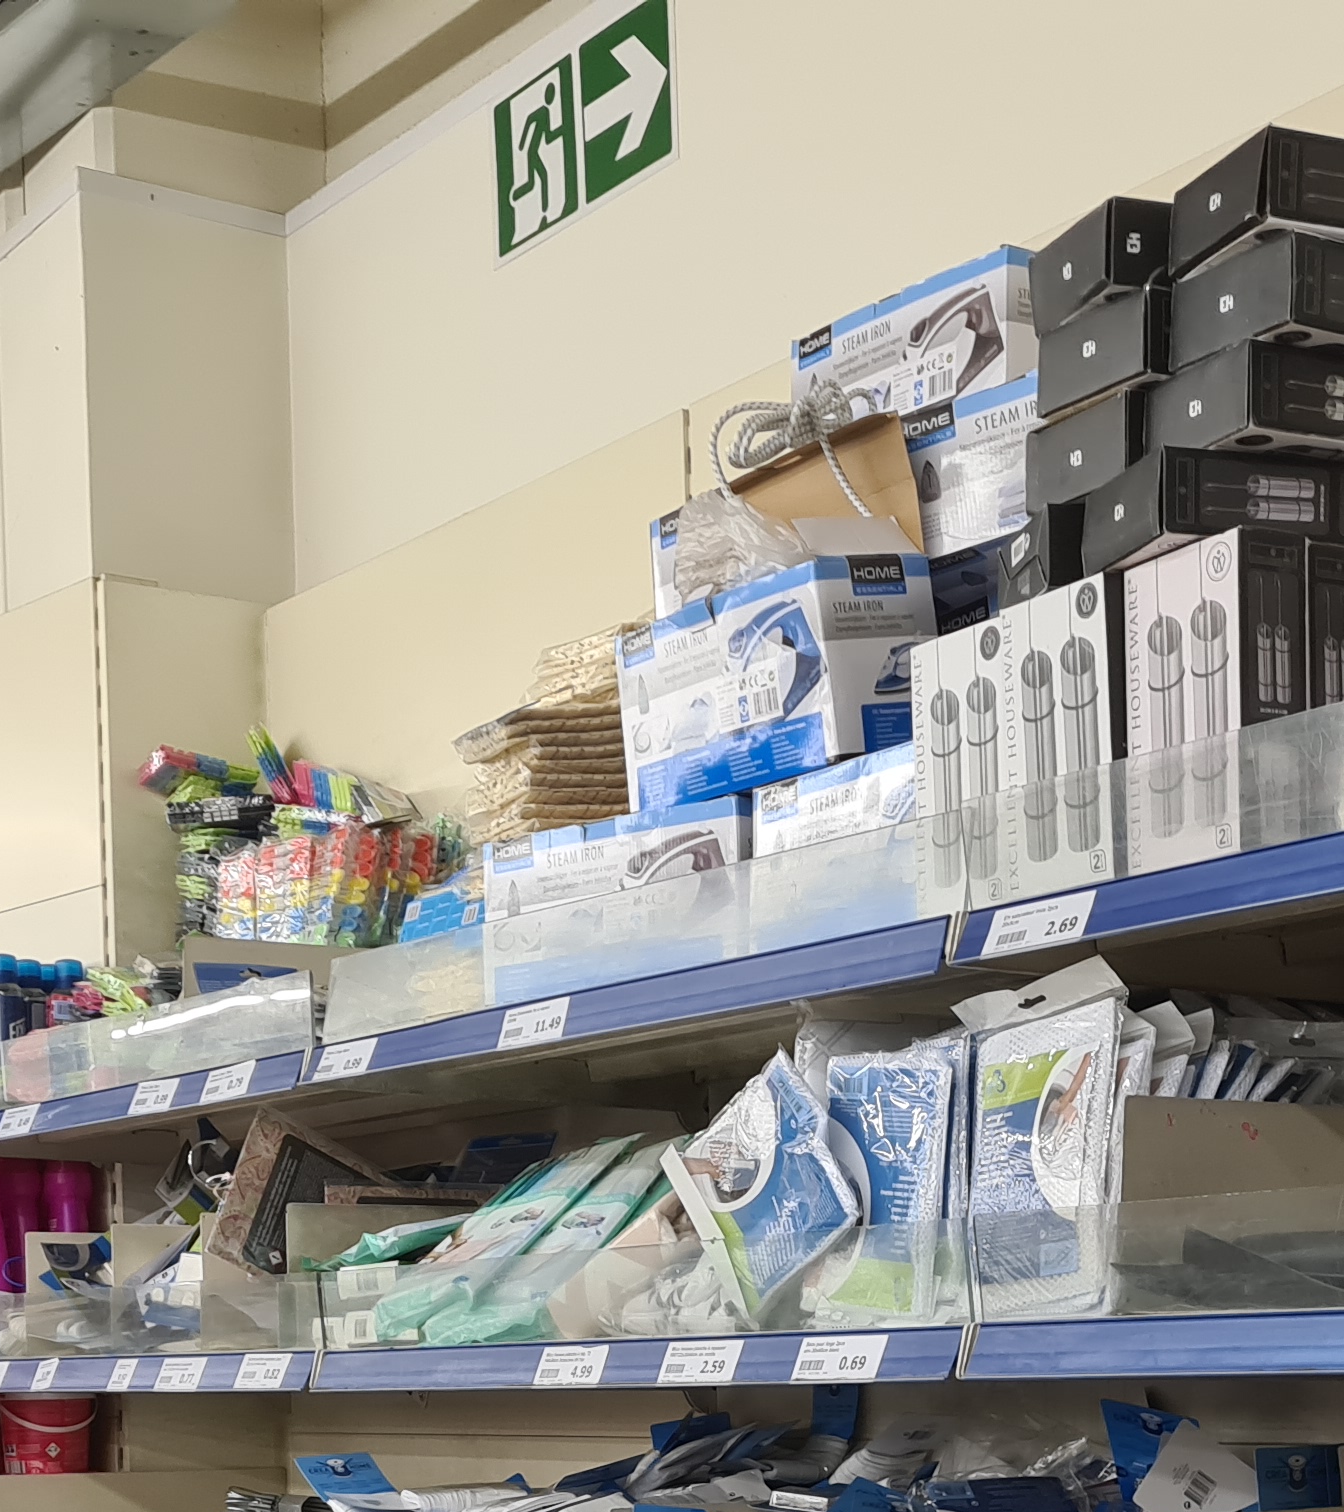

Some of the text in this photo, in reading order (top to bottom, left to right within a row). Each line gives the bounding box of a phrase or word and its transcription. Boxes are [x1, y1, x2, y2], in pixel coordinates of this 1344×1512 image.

[799, 331, 831, 355] HOME
[842, 320, 892, 354] STEAM IRON
[974, 405, 1020, 434] STEAM
[1024, 399, 1038, 417] IR
[853, 565, 901, 582] HOME
[832, 599, 884, 614] STEAM IRON
[663, 635, 690, 659] STEAM
[1129, 578, 1142, 735] HOUSEWARE
[1003, 614, 1017, 761] HOUSEWARE
[494, 840, 532, 861] HOME
[546, 848, 578, 869] STEAM
[580, 844, 605, 865] IRON
[1044, 915, 1079, 937] 2.69
[533, 1016, 562, 1034] 11.49
[570, 1365, 593, 1379] 4.99
[699, 1359, 726, 1374] 2.59
[839, 1355, 867, 1371] 0.69
